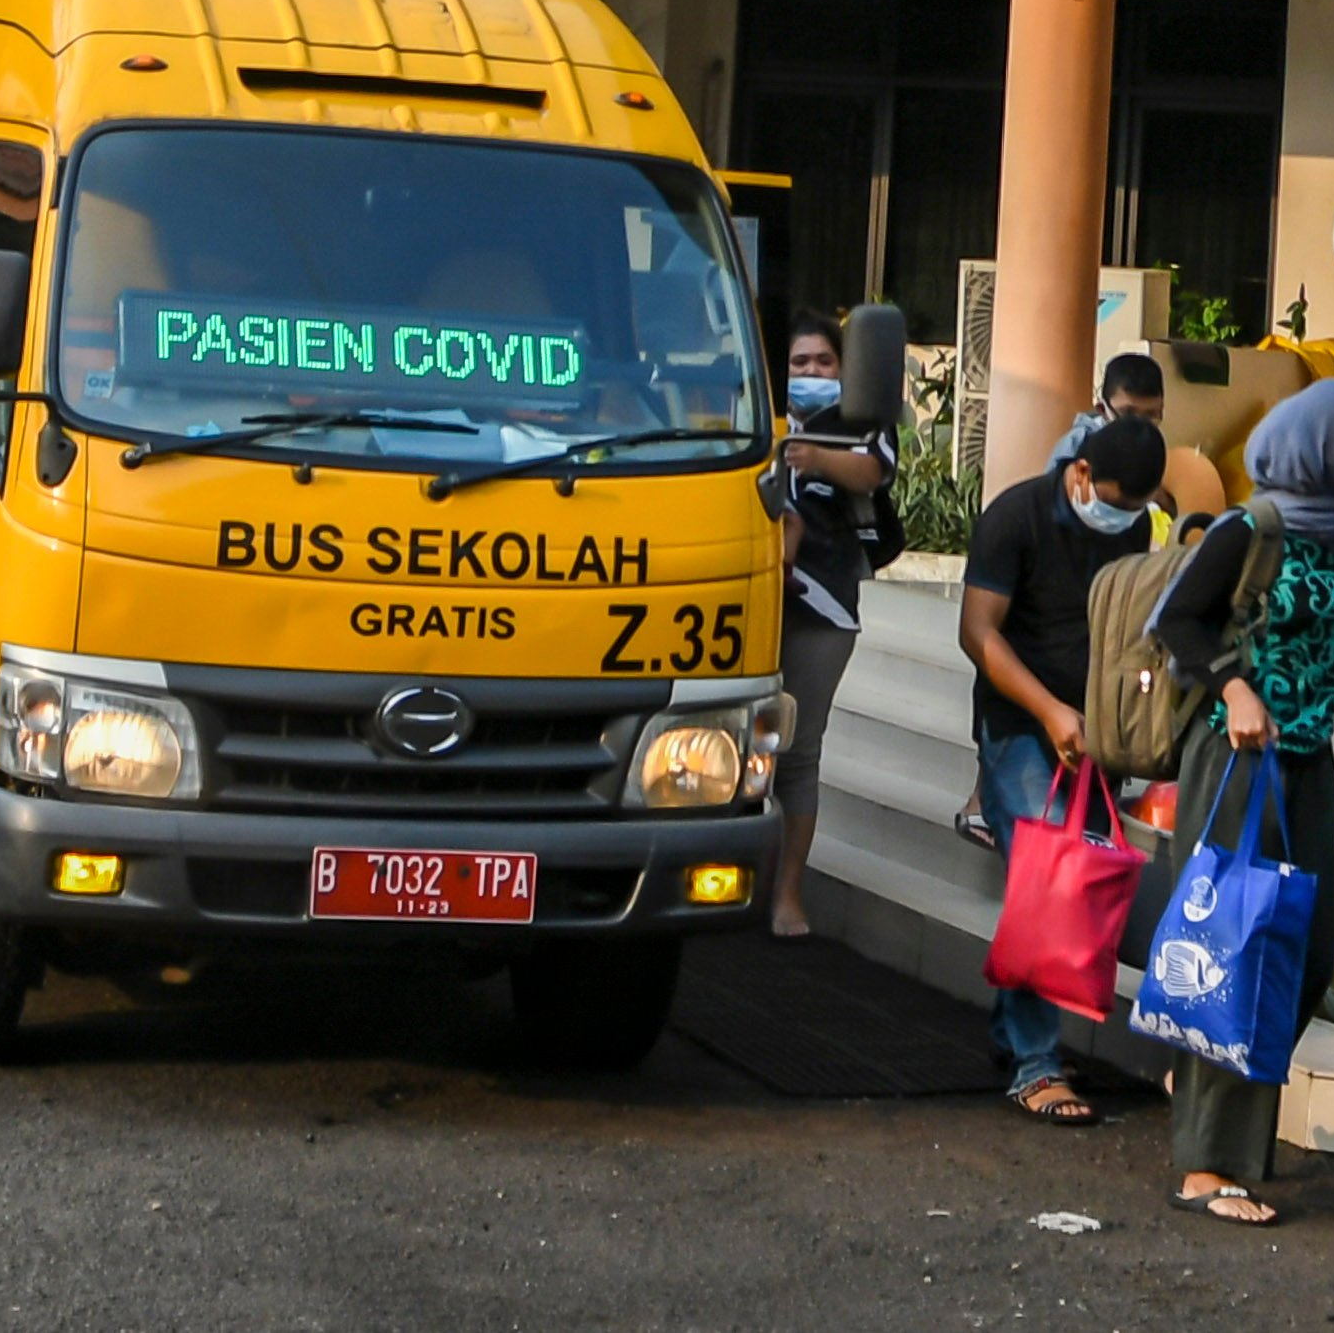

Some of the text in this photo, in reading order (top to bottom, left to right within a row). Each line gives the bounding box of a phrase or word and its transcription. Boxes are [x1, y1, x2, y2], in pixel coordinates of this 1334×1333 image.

[157, 310, 580, 386] PASIEN COVID
[216, 520, 649, 584] BUS SEKOLAH
[350, 603, 517, 640] GRATIS
[601, 603, 745, 672] Z.35
[317, 853, 529, 899] B 7032 TPA
